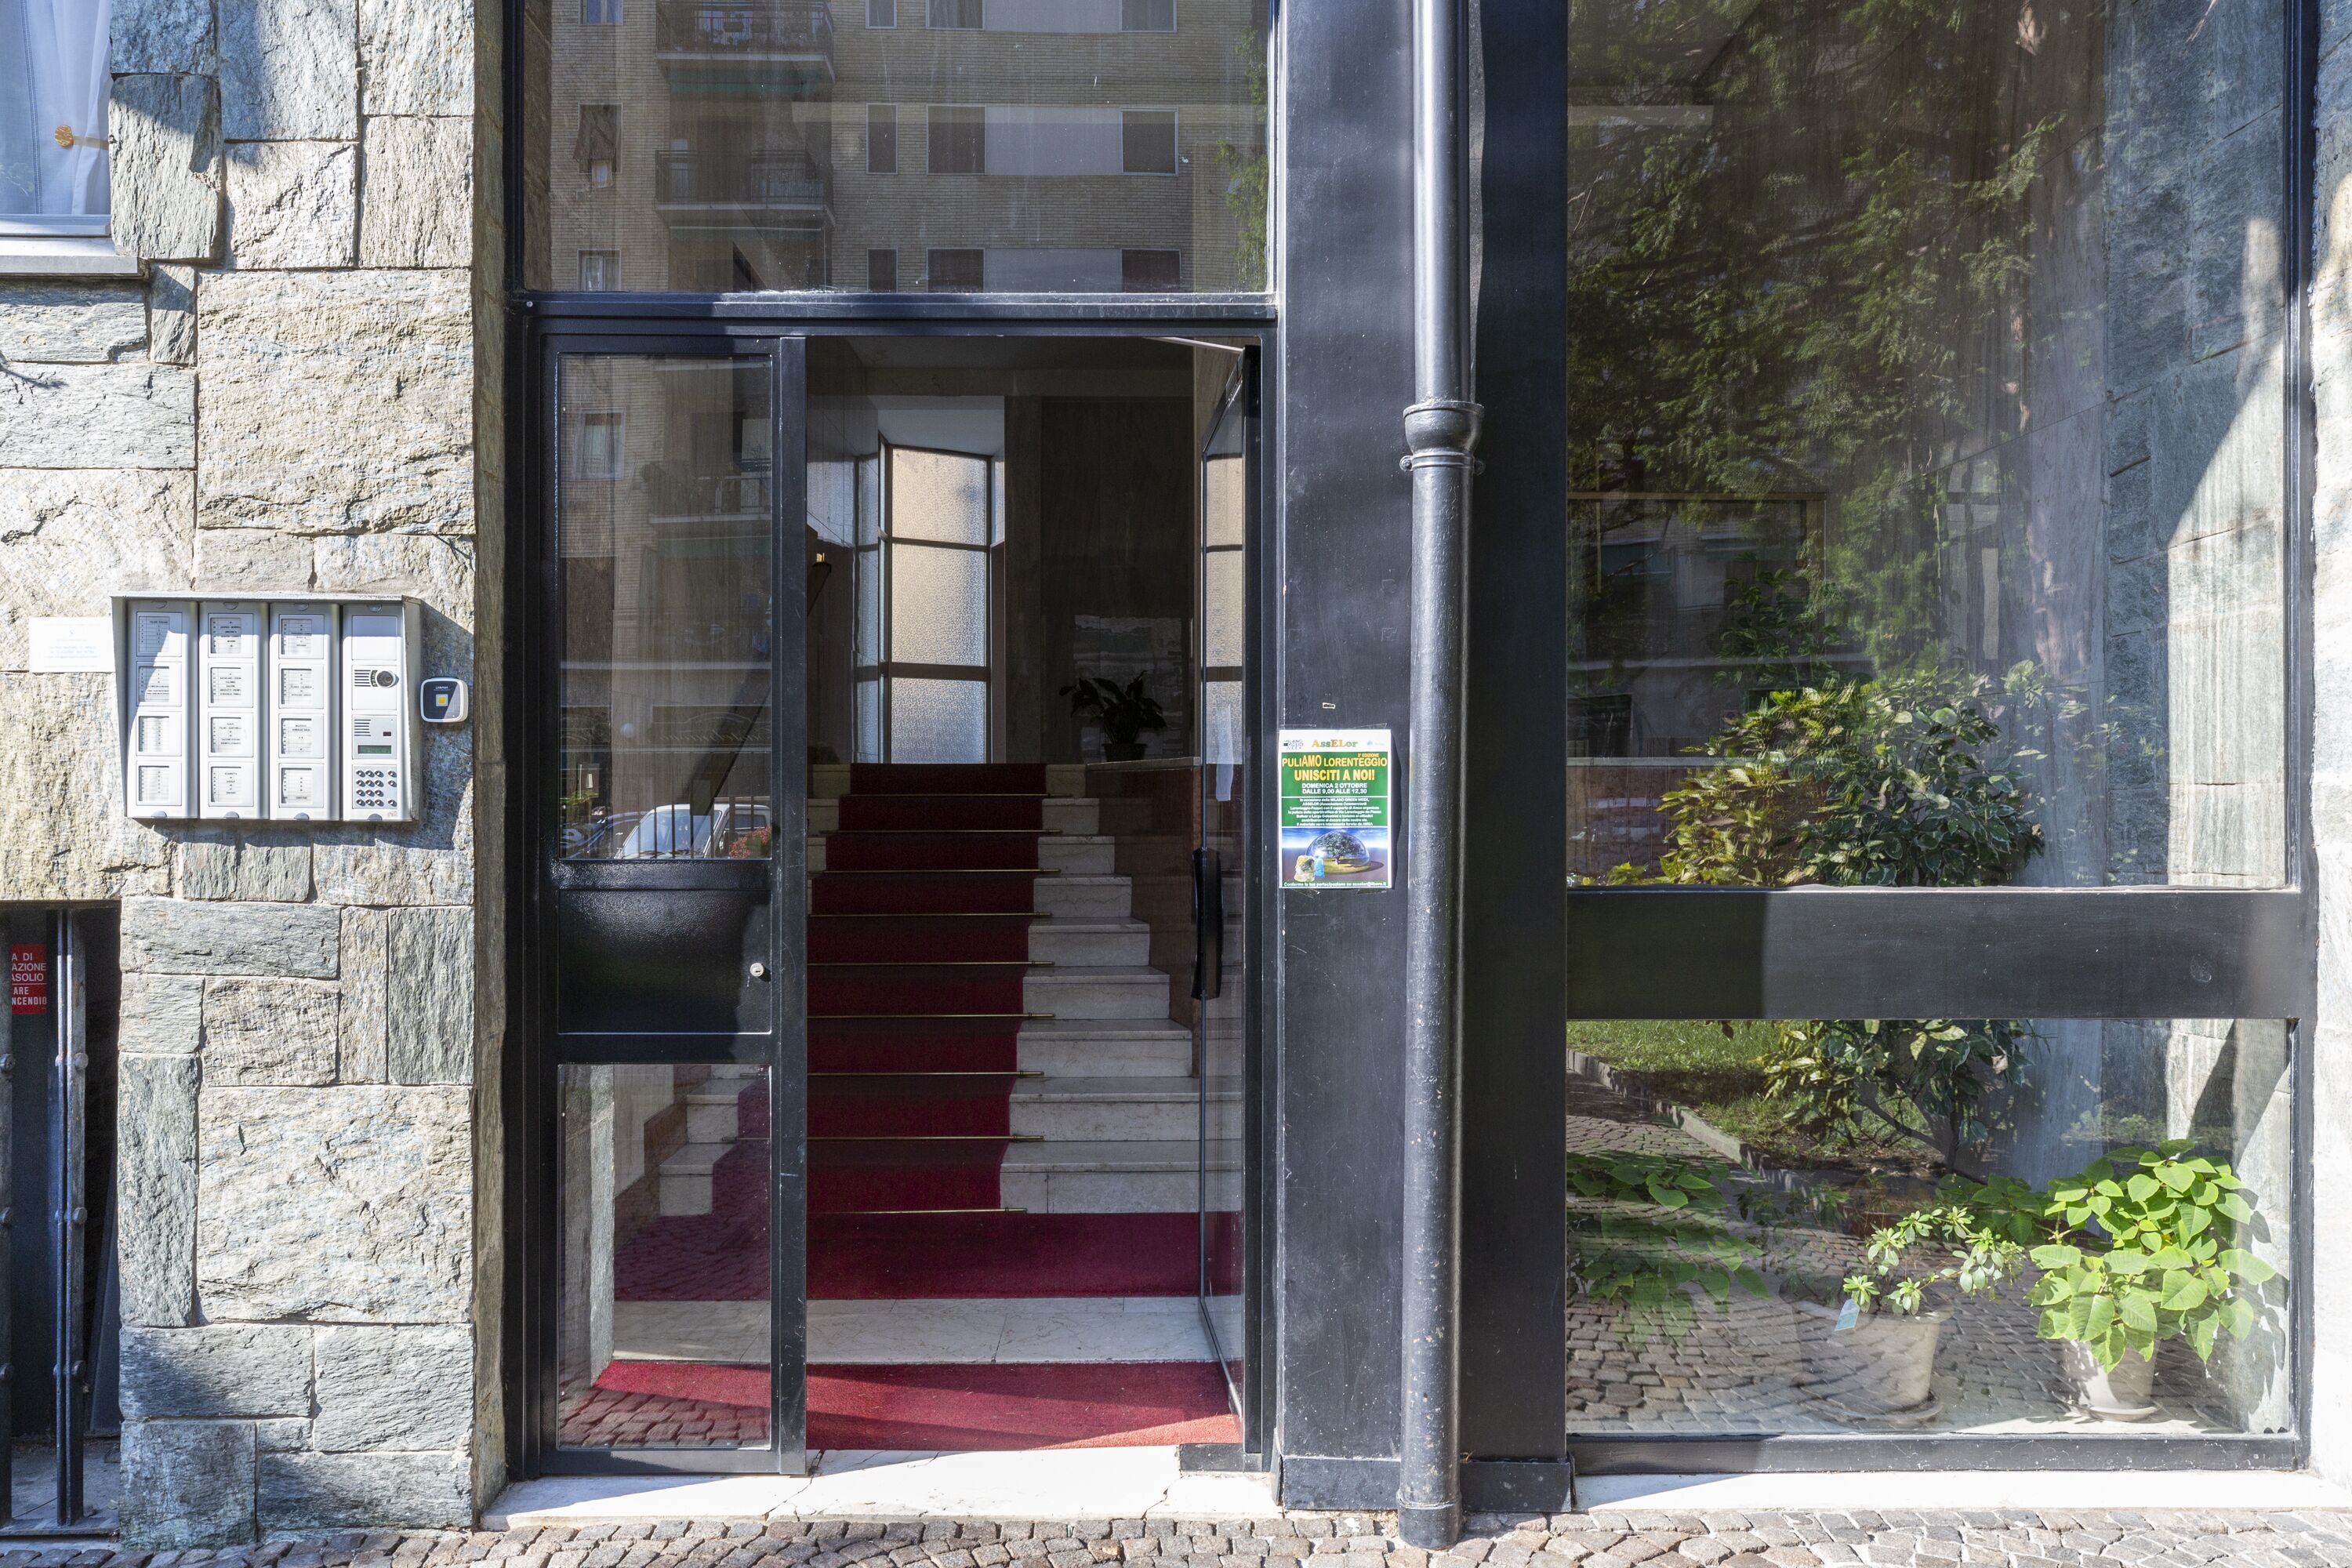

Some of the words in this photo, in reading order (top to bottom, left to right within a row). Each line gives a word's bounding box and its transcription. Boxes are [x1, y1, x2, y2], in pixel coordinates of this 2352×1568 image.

[1294, 769, 1341, 781] UNISCITI
[1342, 769, 1351, 781] A
[1352, 769, 1375, 781] NOI!
[23, 953, 33, 961] DI
